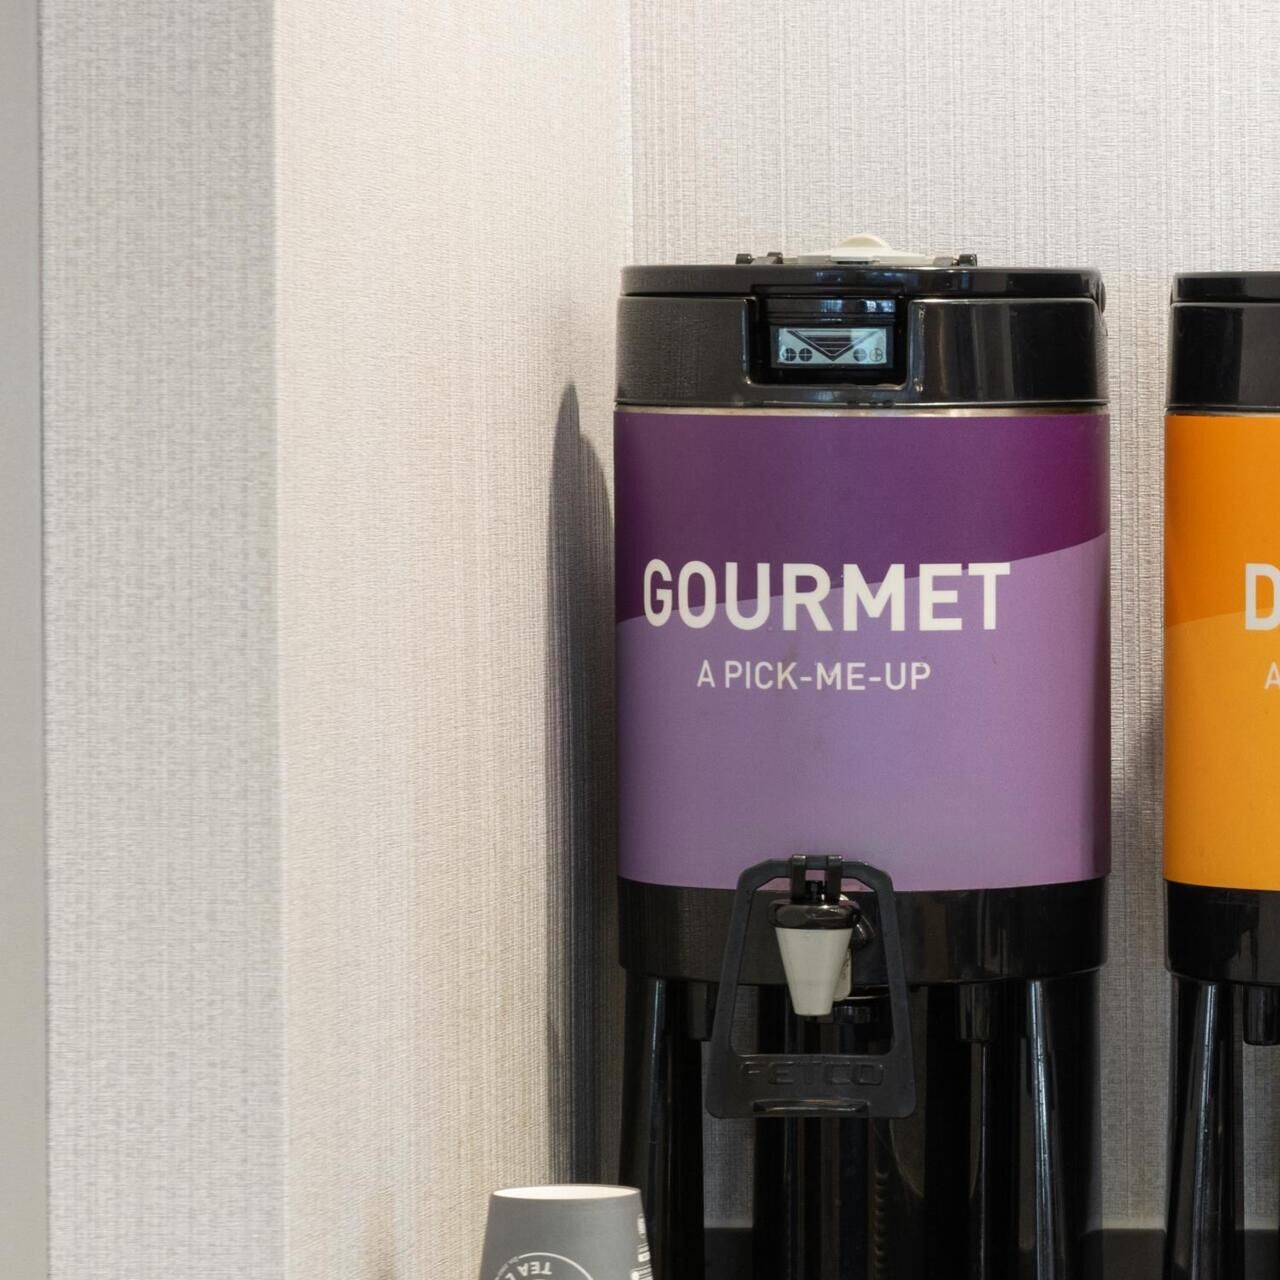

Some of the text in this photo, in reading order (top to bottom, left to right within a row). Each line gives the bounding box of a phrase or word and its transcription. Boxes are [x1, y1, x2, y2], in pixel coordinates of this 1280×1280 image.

[643, 558, 1011, 632] GOURMET
[697, 660, 931, 691] A PICK-ME-UP
[516, 1261, 553, 1277] TEA
